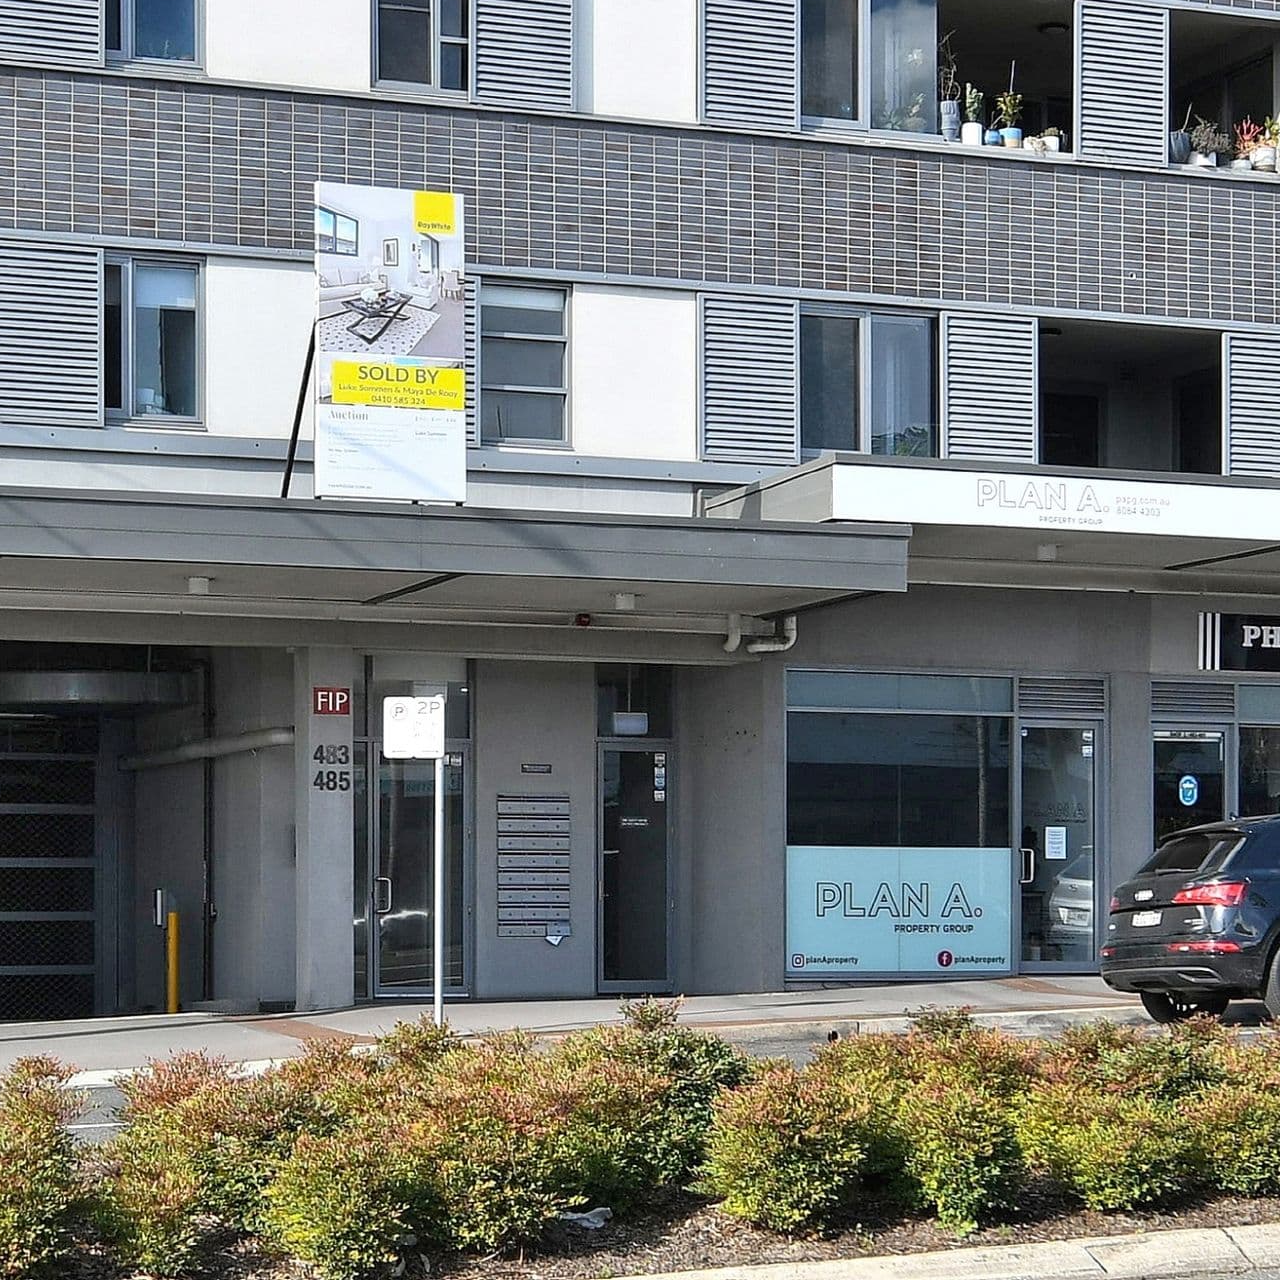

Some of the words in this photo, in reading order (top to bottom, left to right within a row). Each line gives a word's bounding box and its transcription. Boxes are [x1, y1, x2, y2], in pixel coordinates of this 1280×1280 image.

[358, 365, 409, 382] SOLD
[415, 368, 439, 384] BY
[338, 383, 358, 391] Luke
[403, 386, 424, 396] Maya
[426, 388, 437, 396] De
[371, 394, 392, 403] 0410
[328, 409, 369, 421] Auction
[977, 479, 1066, 510] PLAN
[1039, 515, 1076, 524] PROPERTY
[1078, 517, 1103, 525] GROUP
[317, 691, 348, 711] FIP
[417, 701, 440, 714] 2P
[313, 744, 349, 764] 483
[313, 770, 350, 791] 485
[817, 882, 928, 917] PLAN
[894, 923, 940, 933] PROPERTY
[943, 923, 973, 933] GROUP
[805, 955, 859, 965] planAproperty
[954, 955, 1005, 965] planAproperty
